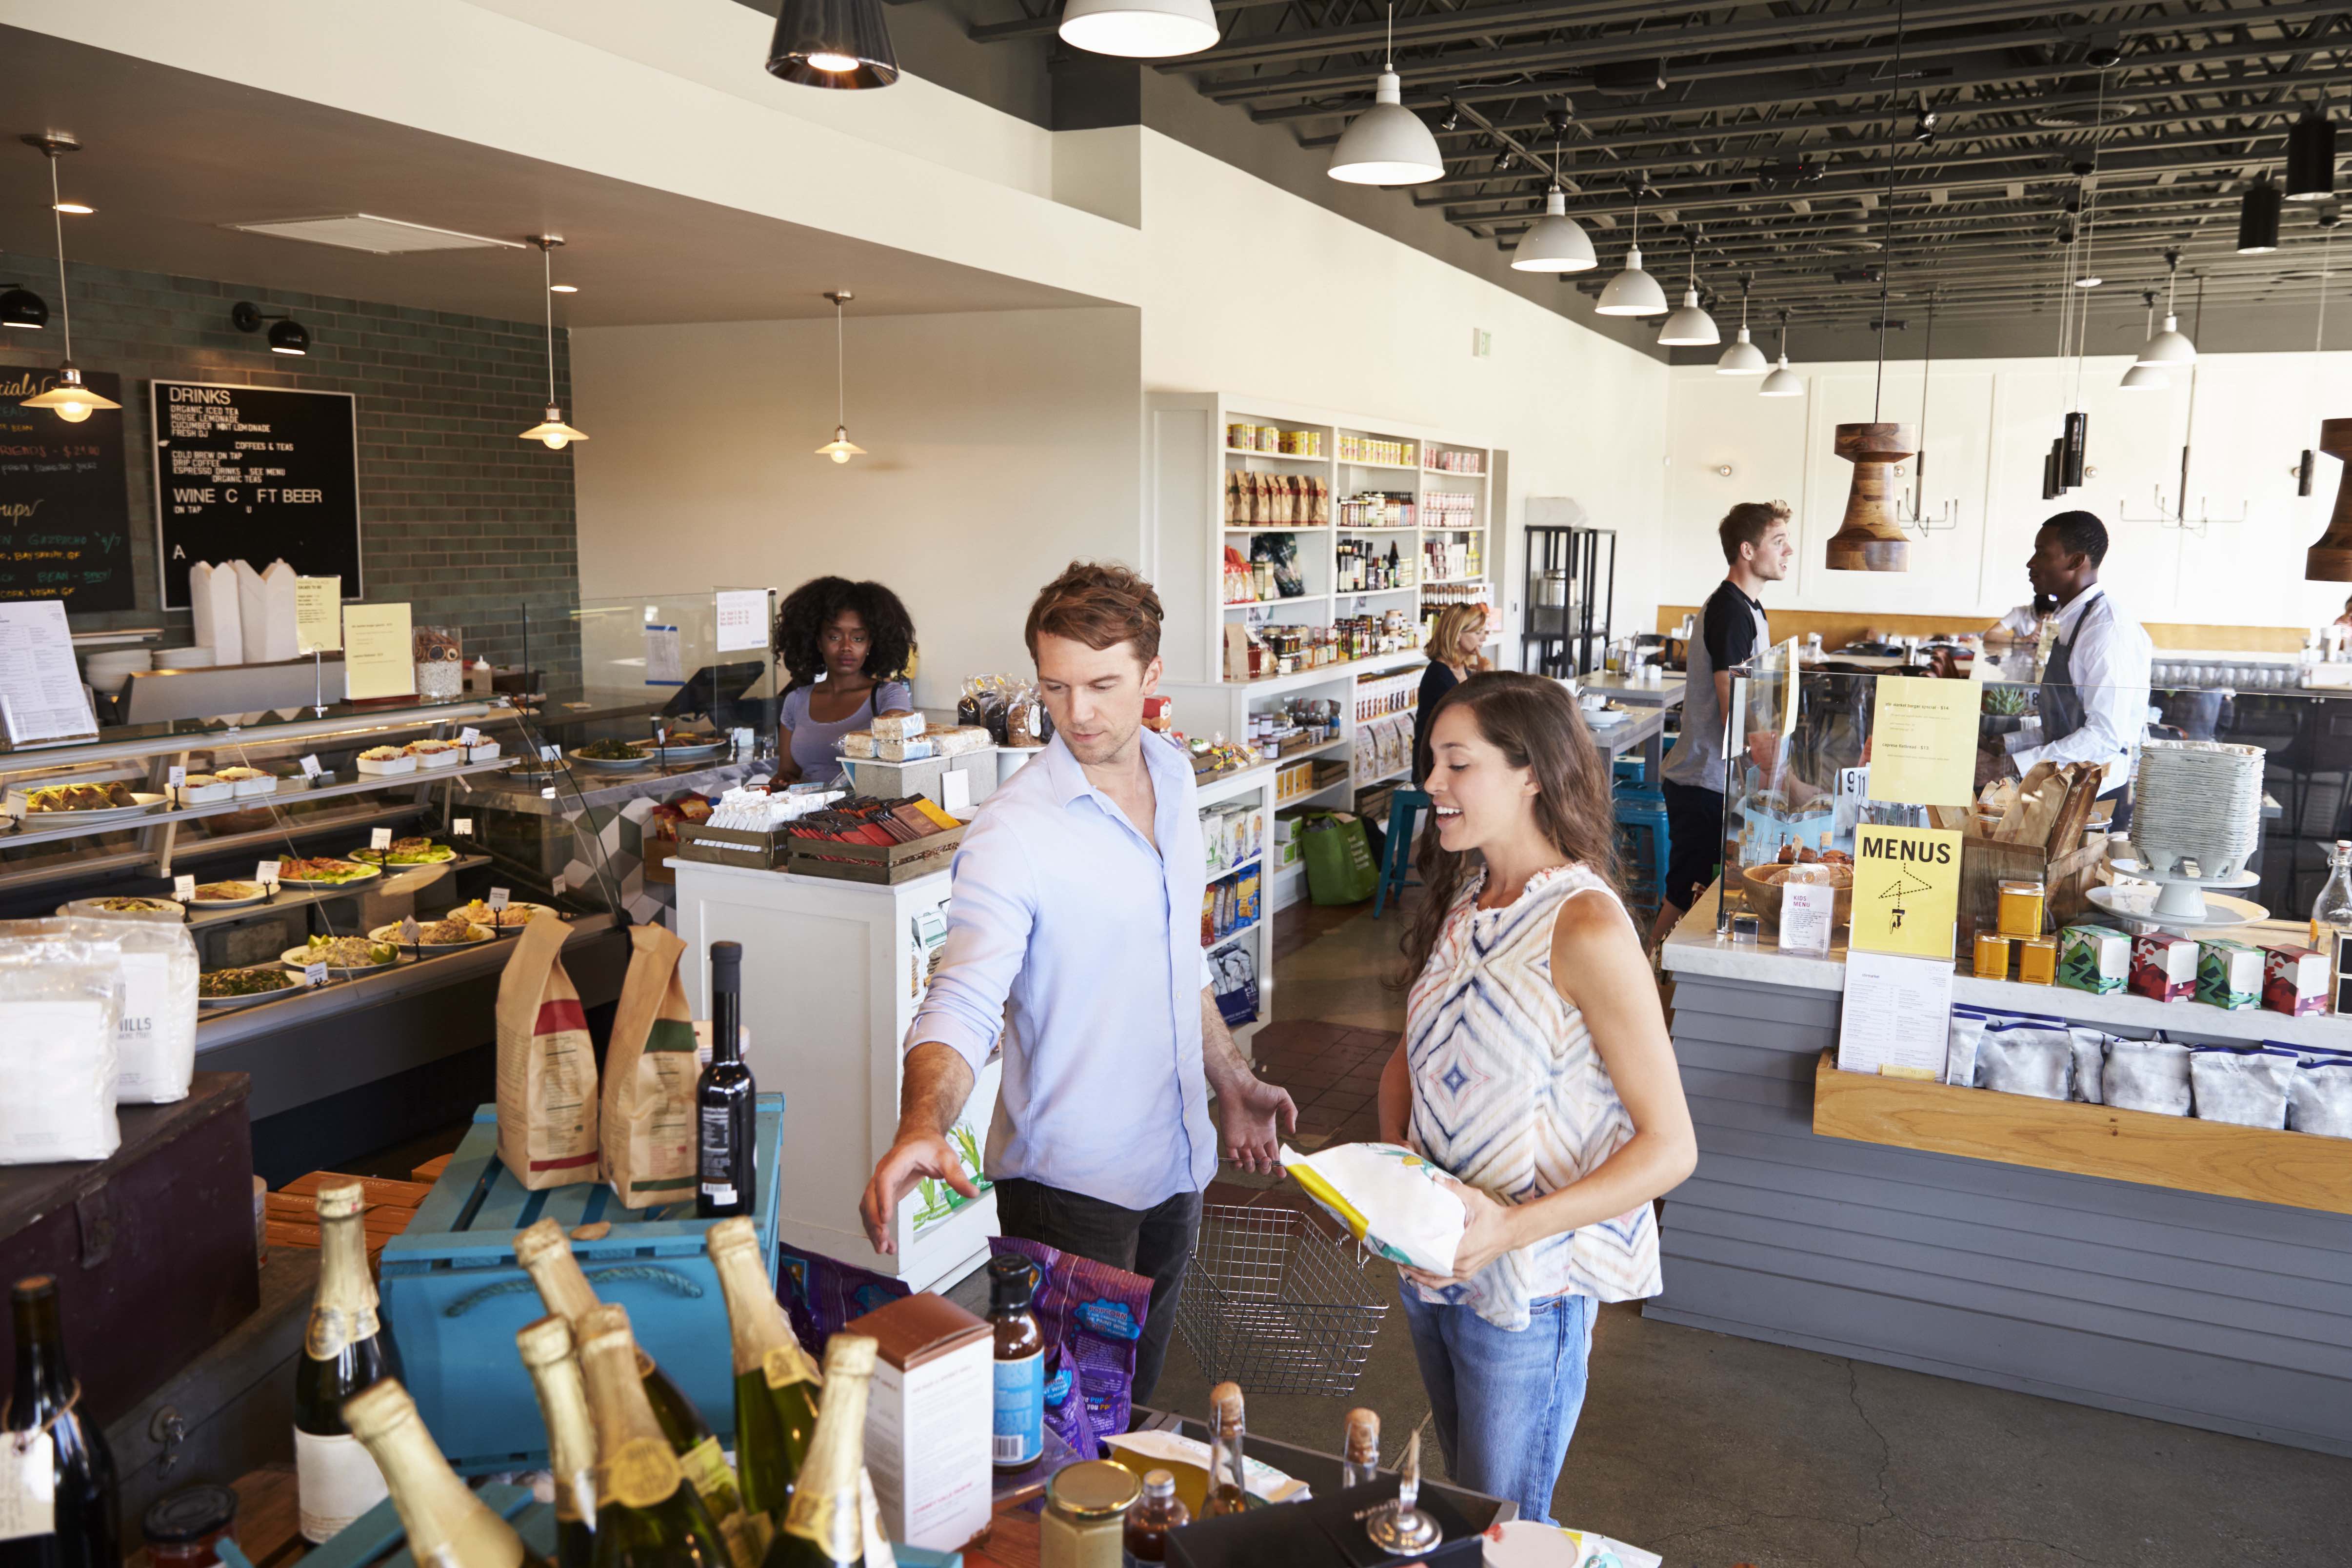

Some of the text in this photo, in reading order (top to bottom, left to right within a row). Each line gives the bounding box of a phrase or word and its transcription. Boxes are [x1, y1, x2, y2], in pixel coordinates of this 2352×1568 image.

[169, 387, 231, 404] DRINKS
[171, 405, 203, 414] ORGANIC
[206, 406, 223, 415] ICED
[171, 414, 239, 424] HOUSE LEMONADE
[171, 421, 212, 430] CUCUMBER
[235, 441, 294, 451] COFFEES & TEAS
[172, 451, 192, 459] COLD
[194, 451, 215, 459] BREW
[174, 488, 216, 503] WINE
[225, 489, 238, 503] C
[282, 489, 322, 503] BEER
[173, 544, 186, 559] A
[2033, 692, 2038, 706] 8
[1847, 771, 1854, 793] 9
[1857, 774, 1865, 796] 11
[1862, 836, 1951, 864] MENUS
[1088, 1305, 1127, 1320] POPCORN
[1096, 1317, 1113, 1327] PAINT
[1113, 1324, 1127, 1332] WITH
